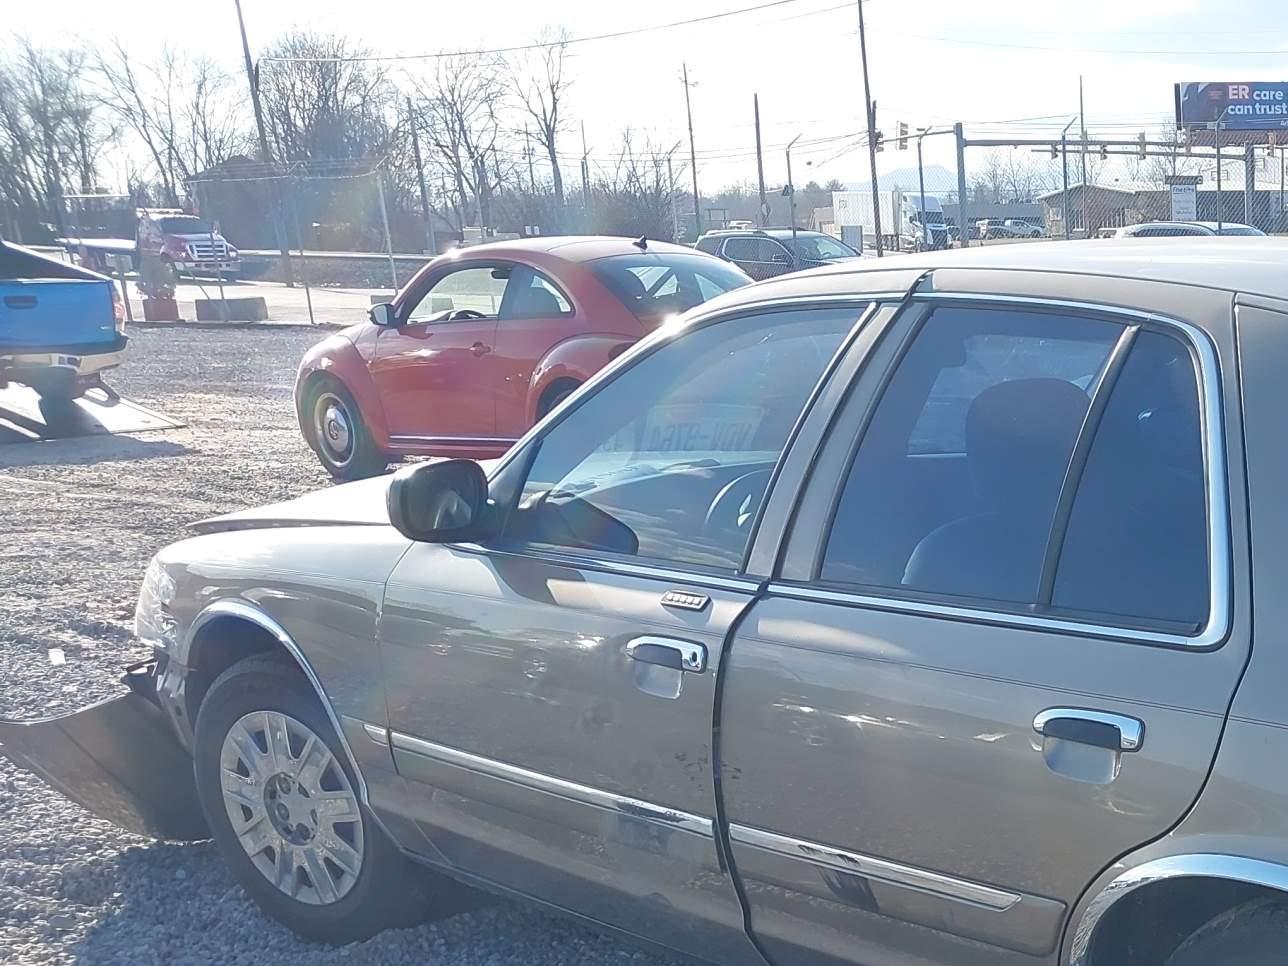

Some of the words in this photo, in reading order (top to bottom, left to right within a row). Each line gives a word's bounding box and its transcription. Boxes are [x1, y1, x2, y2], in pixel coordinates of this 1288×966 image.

[1228, 85, 1250, 99] ER
[1253, 90, 1283, 100] care
[1227, 104, 1253, 115] can
